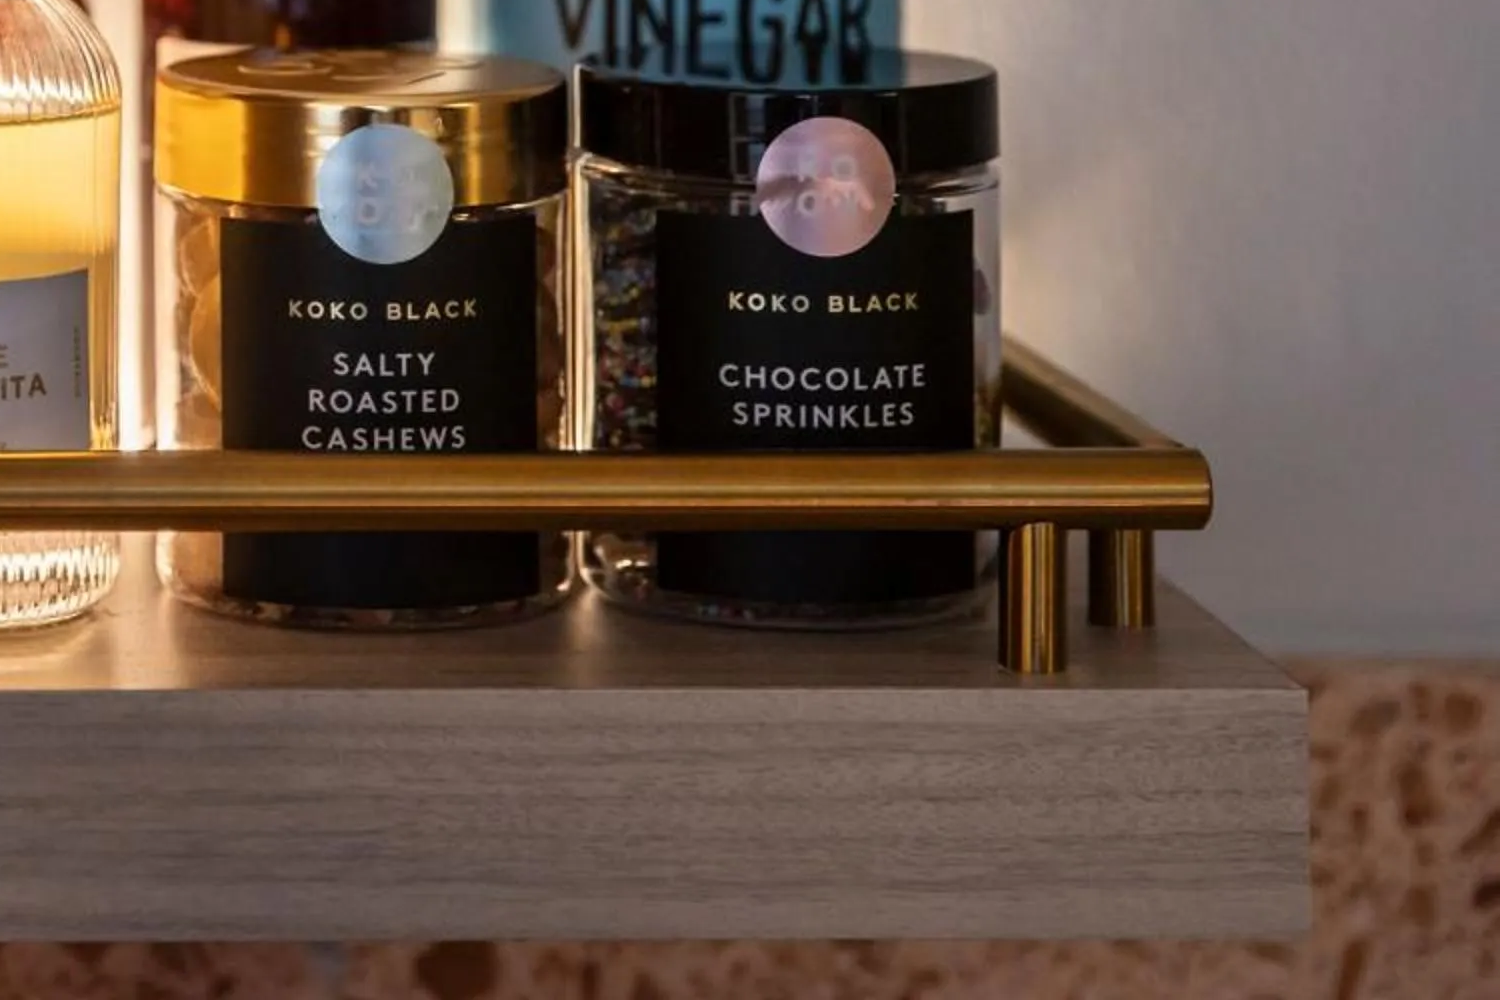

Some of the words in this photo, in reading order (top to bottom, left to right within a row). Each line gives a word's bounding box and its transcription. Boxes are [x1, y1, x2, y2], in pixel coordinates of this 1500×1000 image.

[288, 298, 369, 321] KOKO
[386, 298, 477, 321] BLACK
[728, 291, 811, 313] KOKO
[827, 292, 919, 313] BLACK
[332, 352, 436, 377] SALTY
[718, 363, 927, 391] CHOCOLATE
[307, 388, 461, 414] ROASTED
[731, 401, 916, 429] SPRINKLES
[301, 425, 467, 451] CASHEWS
